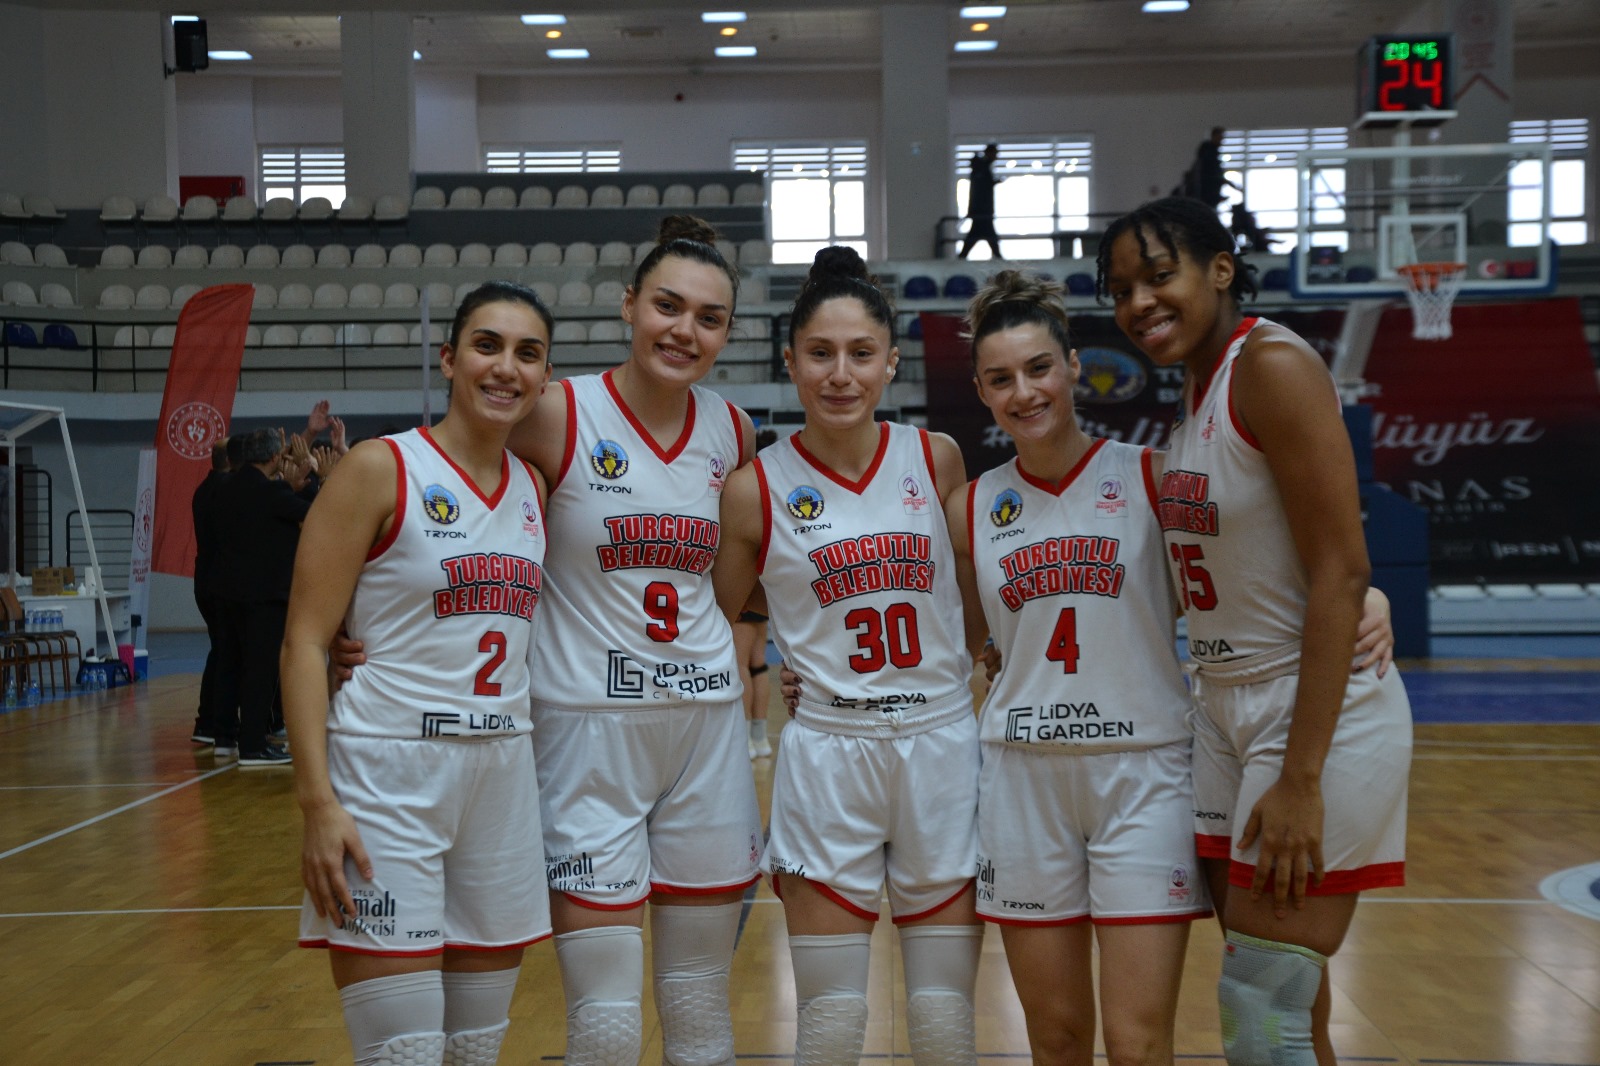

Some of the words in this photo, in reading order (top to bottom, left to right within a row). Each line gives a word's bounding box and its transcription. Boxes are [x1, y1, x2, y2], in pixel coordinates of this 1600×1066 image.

[1379, 59, 1443, 111] 24
[588, 483, 632, 494] TRYON
[424, 530, 467, 539] TRYON
[604, 514, 719, 549] TURGUTLU
[792, 523, 832, 535] TRYON
[990, 528, 1025, 543] TRYON
[808, 532, 931, 577] TURGUTLU
[1000, 535, 1120, 582] TURGUTLU
[441, 552, 542, 592] TURGUTLU
[810, 560, 936, 608] BELEDİYESİ
[1000, 562, 1125, 612] BELEDİYESİ
[433, 582, 539, 622] BELEDİYES
[643, 581, 680, 642] 9
[844, 602, 923, 674] 30
[1045, 607, 1080, 674] 4
[473, 631, 507, 696] 2
[655, 662, 707, 679] iDYA
[652, 671, 731, 694] GRDEN
[652, 691, 697, 701] CITY
[1037, 721, 1134, 740] GARDEN
[1192, 810, 1227, 820] RYON
[605, 878, 638, 890] TRYON
[341, 891, 396, 917] malı
[1001, 900, 1045, 910] TRYON
[406, 930, 440, 939] TRYON
